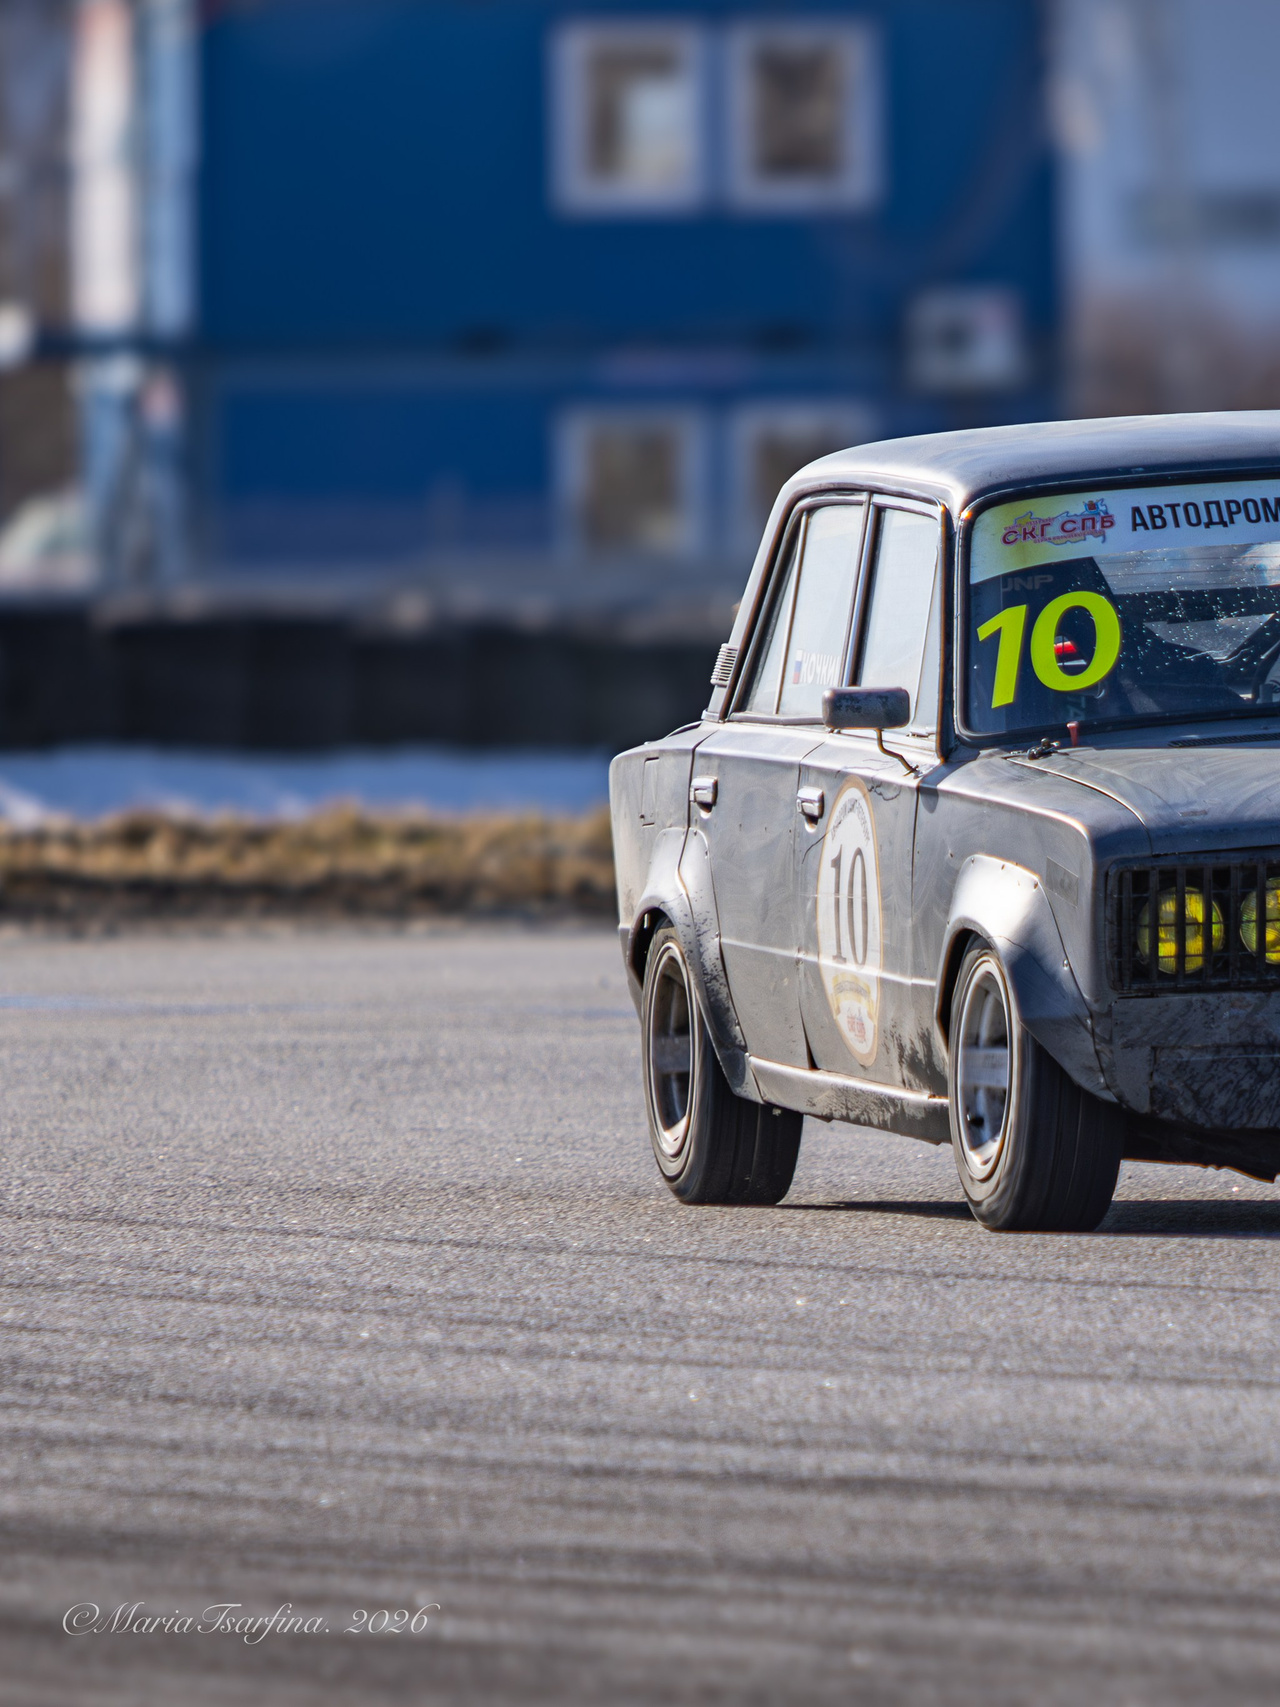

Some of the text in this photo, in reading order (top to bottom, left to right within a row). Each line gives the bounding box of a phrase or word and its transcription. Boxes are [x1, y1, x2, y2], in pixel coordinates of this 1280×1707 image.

[1001, 522, 1052, 546] СКГ
[1060, 514, 1117, 535] СПБ
[976, 590, 1121, 709] 10
[830, 843, 868, 972] 10
